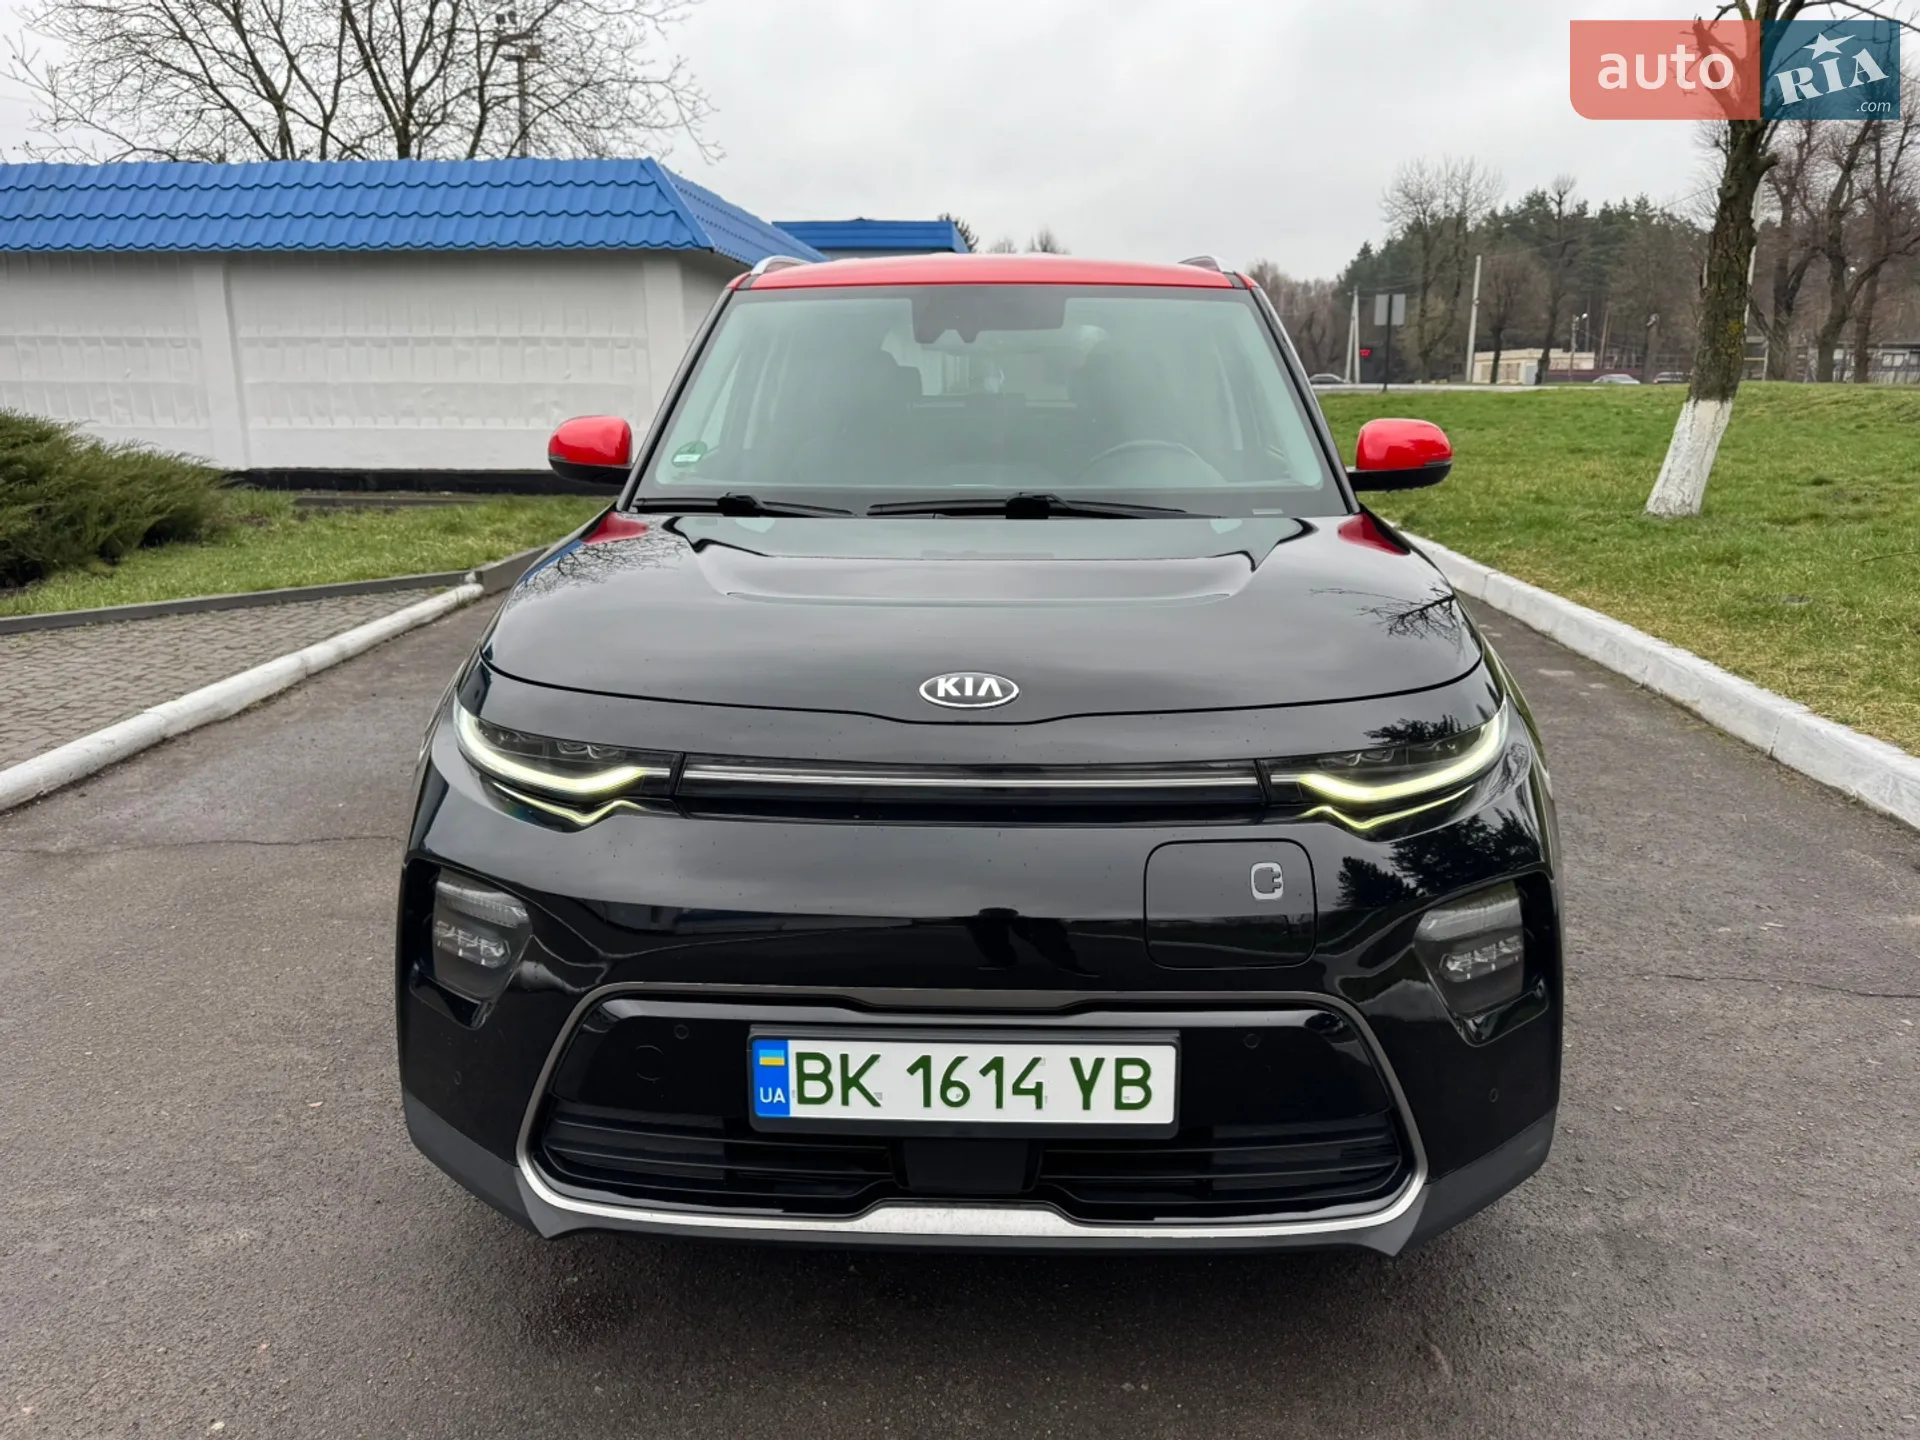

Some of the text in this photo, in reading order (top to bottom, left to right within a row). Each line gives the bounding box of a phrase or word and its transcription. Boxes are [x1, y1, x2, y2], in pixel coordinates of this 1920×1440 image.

[937, 677, 1003, 697] KIA
[796, 1052, 1152, 1110] BK 1614 YB
[760, 1087, 786, 1103] UA
